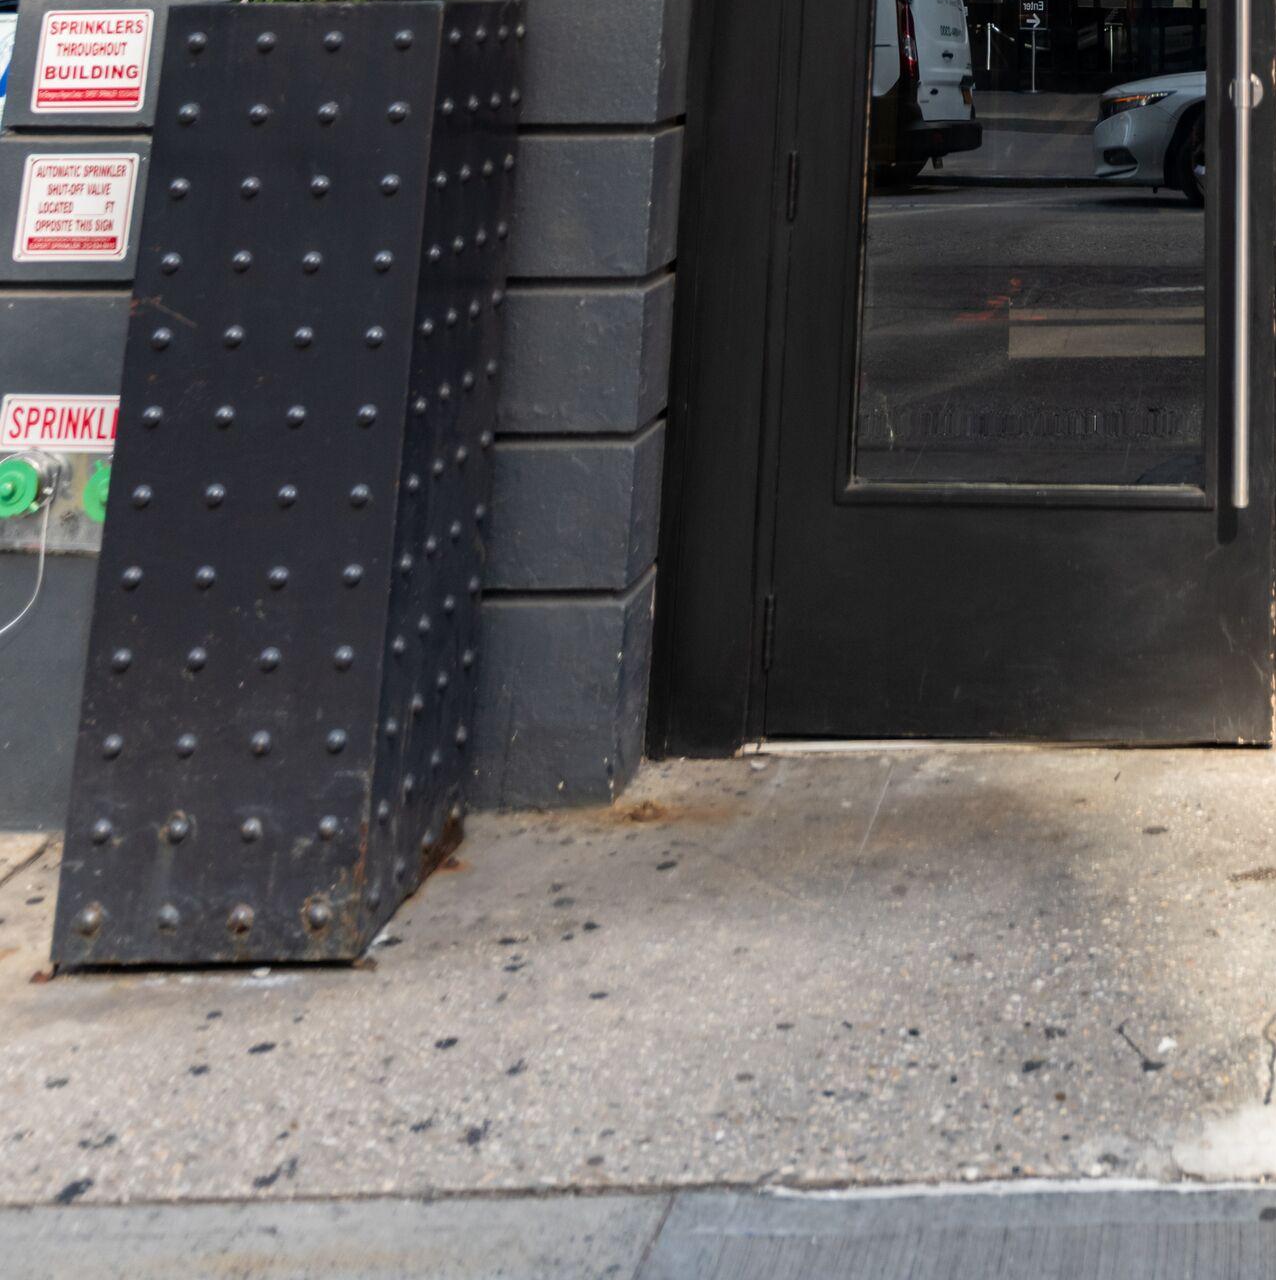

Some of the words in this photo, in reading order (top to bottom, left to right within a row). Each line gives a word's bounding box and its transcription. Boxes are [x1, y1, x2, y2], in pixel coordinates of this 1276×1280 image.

[50, 20, 144, 35] SPRINKLERS
[57, 42, 127, 56] THROUGHOUT
[45, 65, 139, 80] BUILDING
[36, 166, 80, 177] AUTOMATIC
[83, 165, 127, 177] SPRINKLER
[47, 183, 85, 195] SHUT-OFF
[87, 183, 111, 195] VALVE
[38, 201, 73, 214] LOCATED
[105, 201, 115, 213] FT
[35, 220, 72, 232] OPPOSITE
[75, 220, 93, 231] THIS
[95, 220, 113, 231] SIGN
